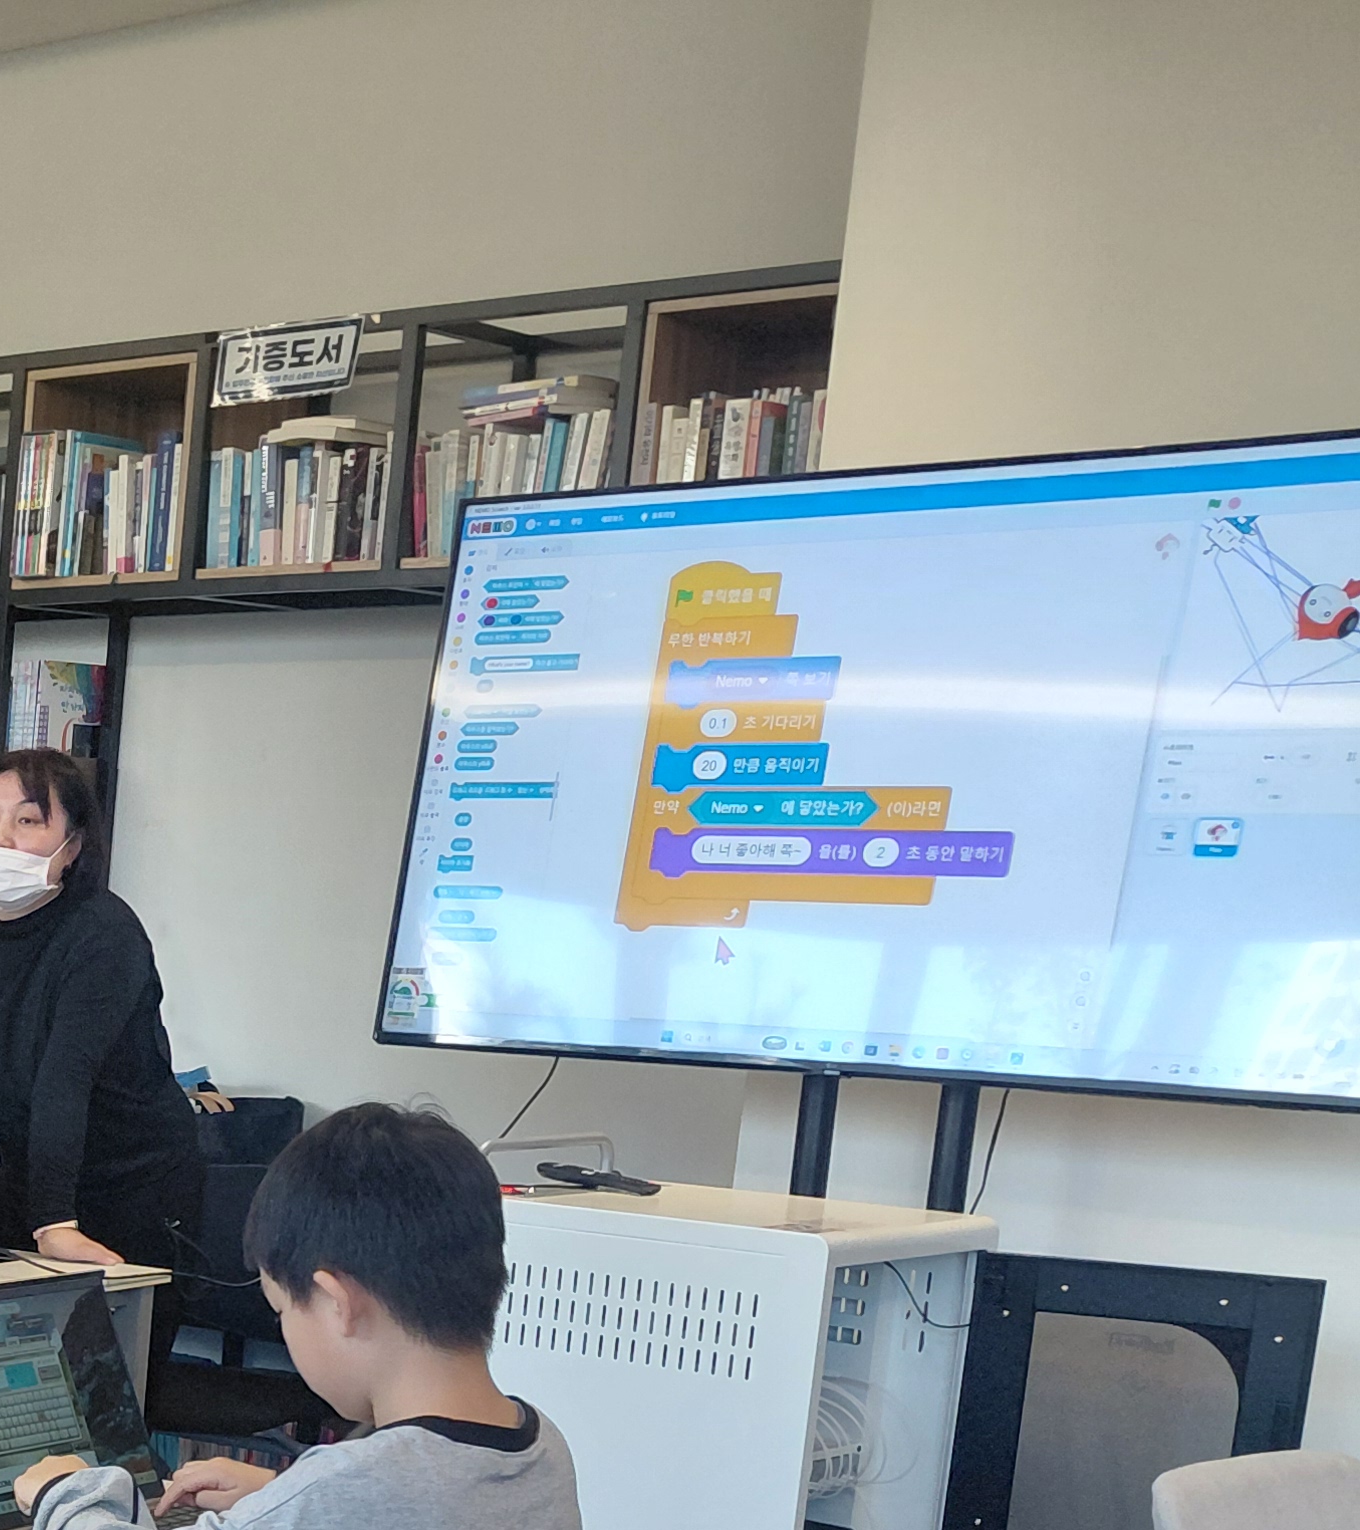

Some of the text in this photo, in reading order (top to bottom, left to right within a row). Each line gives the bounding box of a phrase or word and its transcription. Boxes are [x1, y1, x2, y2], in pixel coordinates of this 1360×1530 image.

[234, 334, 345, 375] 기증도서
[701, 586, 772, 605] 클릭했을 때
[667, 630, 751, 648] 무한 반복하기
[715, 674, 752, 688] Nemo
[804, 670, 830, 686] 보기
[708, 714, 816, 730] 0.1 초 기다리기
[701, 756, 819, 774] 20 만큼 움직이기
[653, 799, 941, 818] 만약 Nemo 에 닿았는가? (이)라면
[701, 842, 714, 856] 나
[718, 842, 732, 858] 너
[735, 842, 776, 858] 좋아해
[818, 843, 856, 861] 을(를)
[875, 846, 885, 860] 2
[905, 845, 921, 861] 초
[925, 844, 955, 862] 동안
[959, 845, 1003, 863] 말하기
